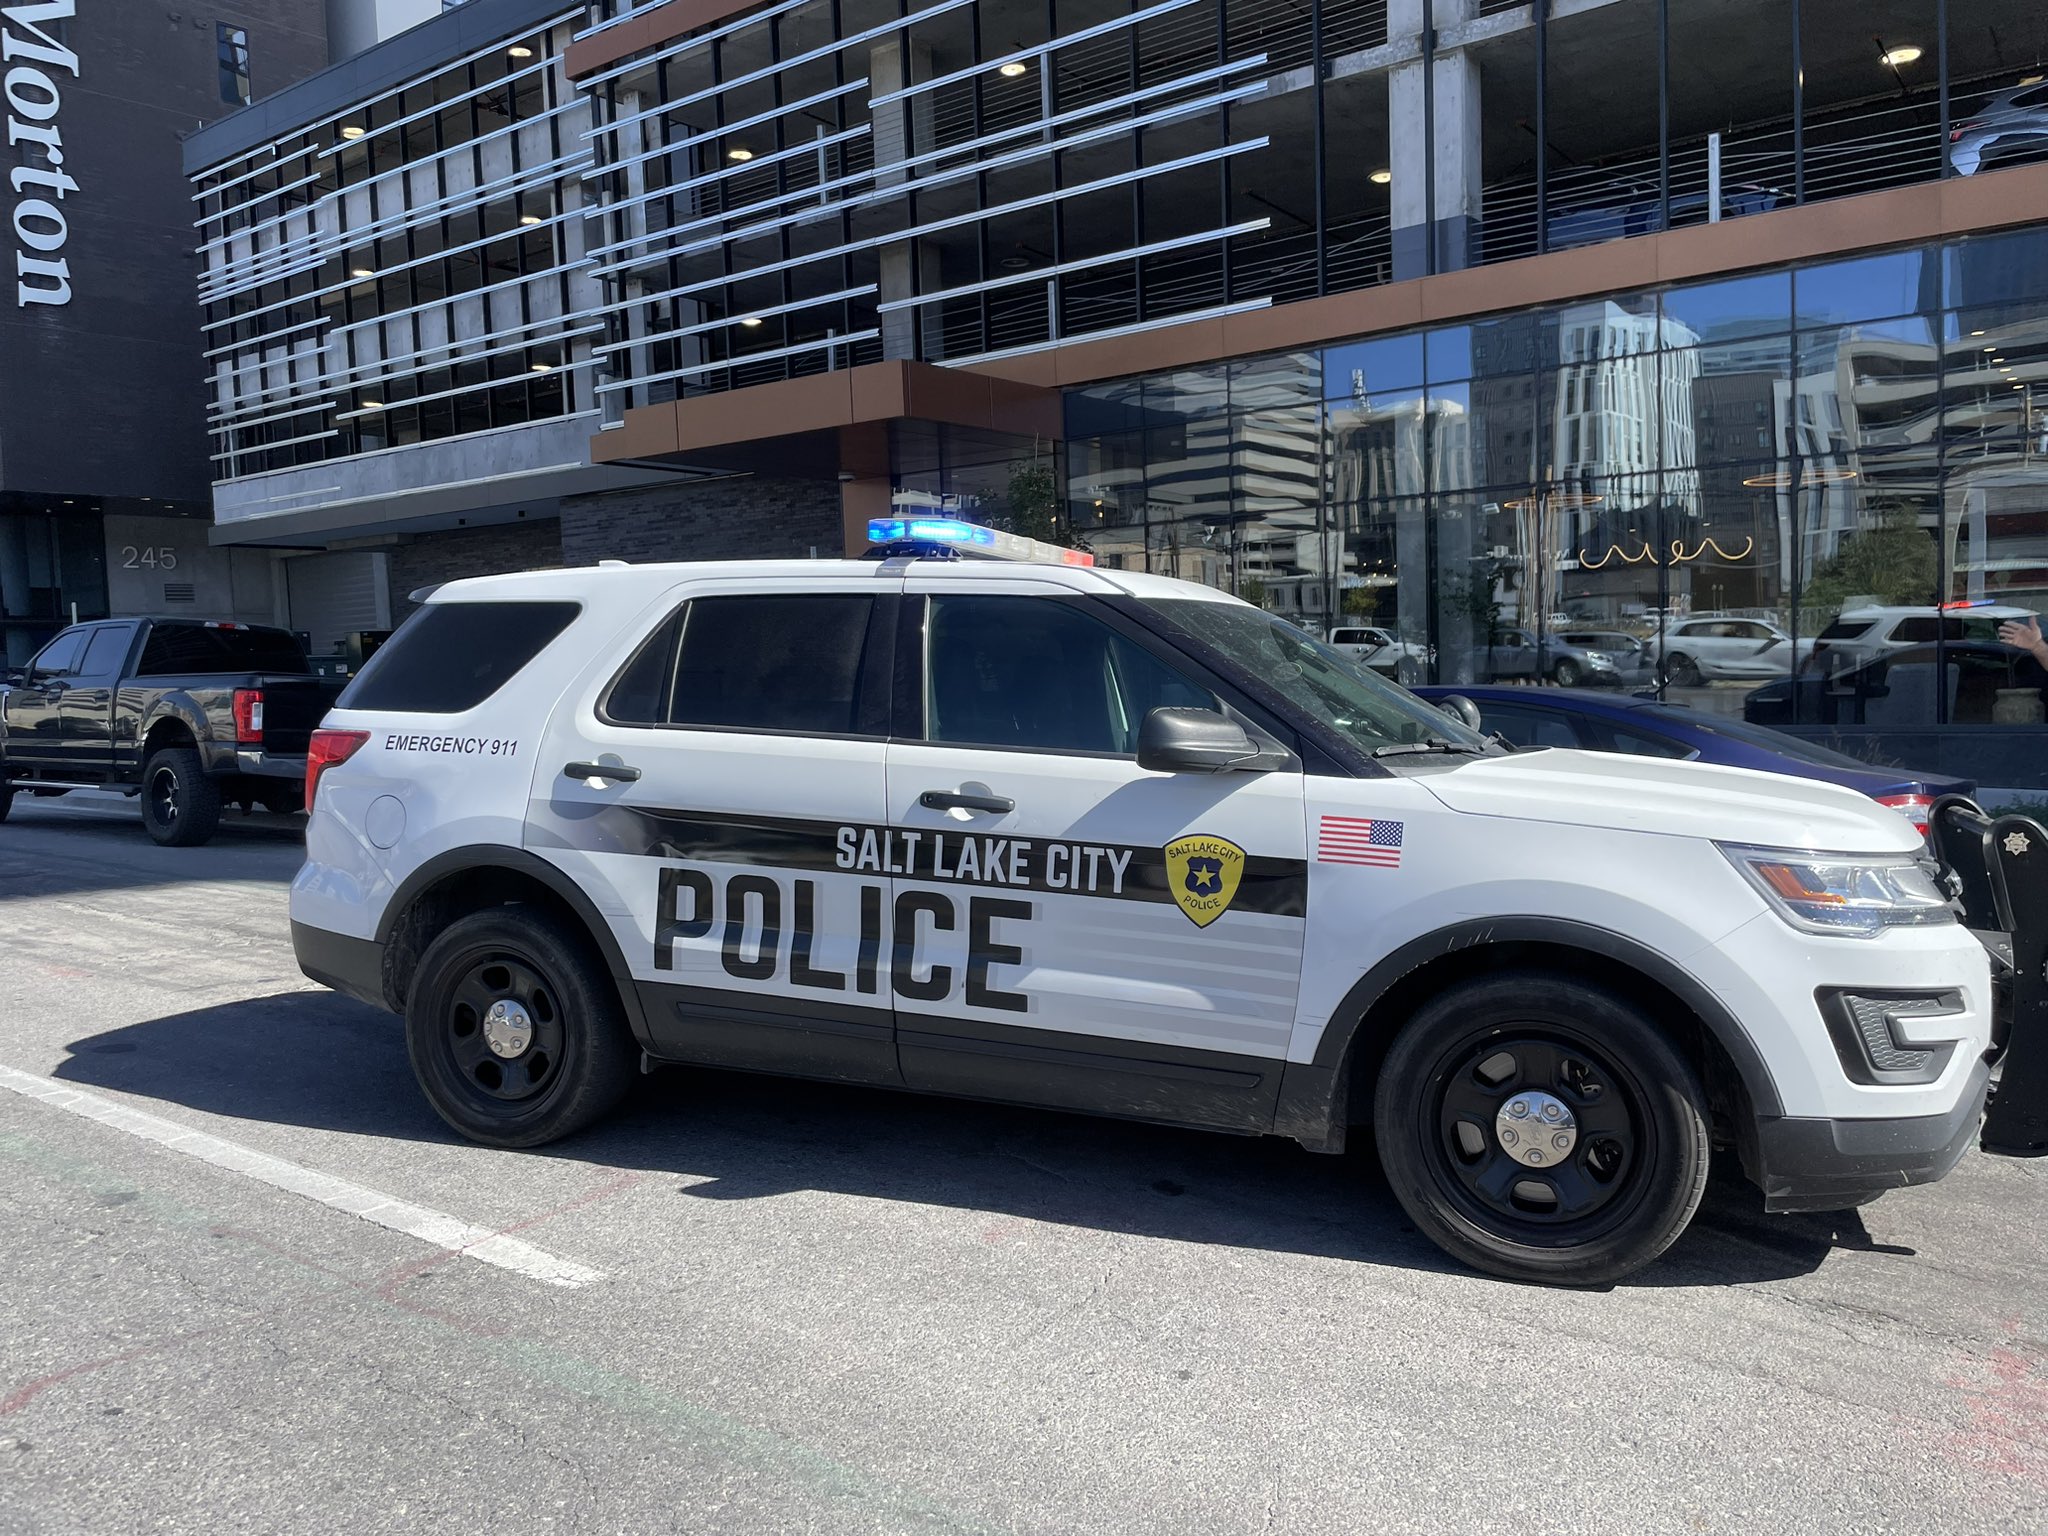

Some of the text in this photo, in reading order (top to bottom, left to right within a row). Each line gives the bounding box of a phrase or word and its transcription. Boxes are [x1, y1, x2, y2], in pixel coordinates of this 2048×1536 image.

[1, 0, 80, 307] Morton
[122, 545, 176, 570] 245
[385, 735, 518, 756] EMERGENCY 911
[835, 826, 1133, 894] SALT LAKE CITY
[1168, 842, 1241, 863] SALT LAKE CITY
[1183, 895, 1221, 910] POLICE
[654, 866, 1036, 1014] POLICE
